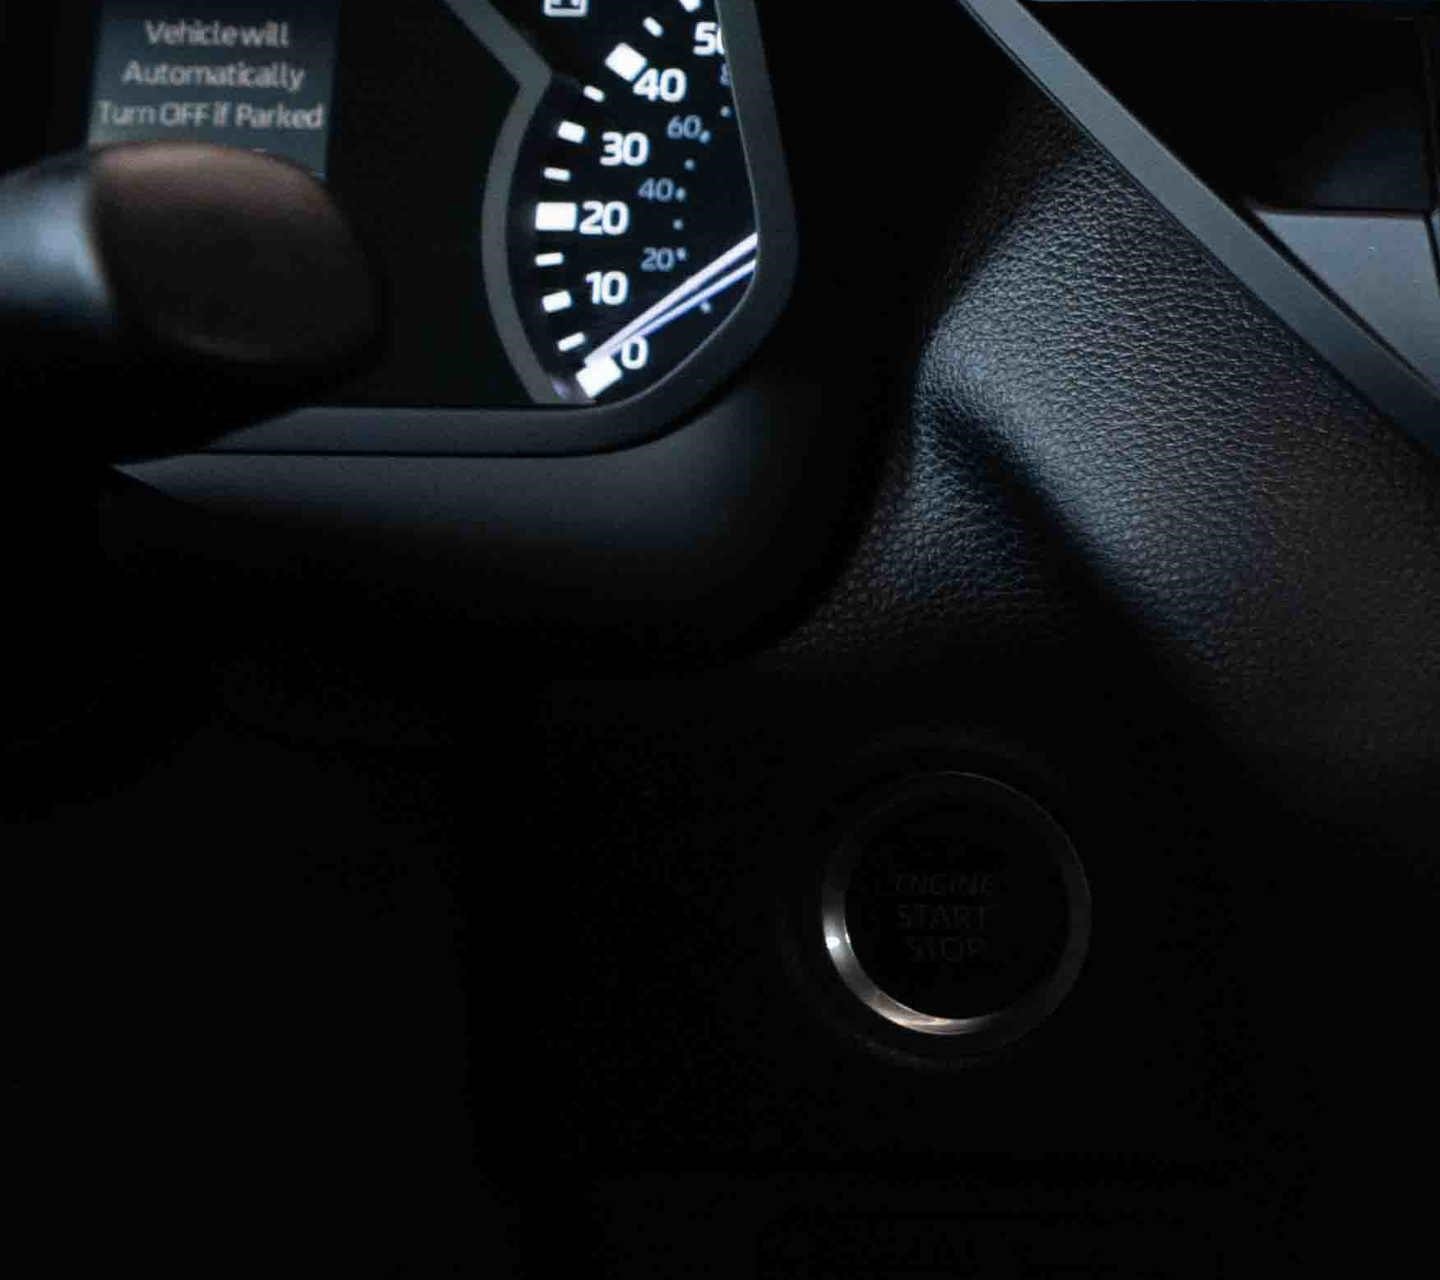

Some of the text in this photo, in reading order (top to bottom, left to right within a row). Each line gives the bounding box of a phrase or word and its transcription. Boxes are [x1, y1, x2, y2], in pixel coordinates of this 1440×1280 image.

[145, 20, 289, 48] Vehicle will
[121, 60, 304, 94] Automatically
[632, 67, 688, 103] 40
[96, 99, 324, 130] Turn OFF if Parked
[666, 114, 702, 140] 60
[599, 130, 650, 167] 30
[637, 177, 676, 203] 40
[579, 200, 630, 236] 20
[640, 246, 676, 272] 20
[585, 270, 629, 306] 10
[620, 335, 649, 371] 0
